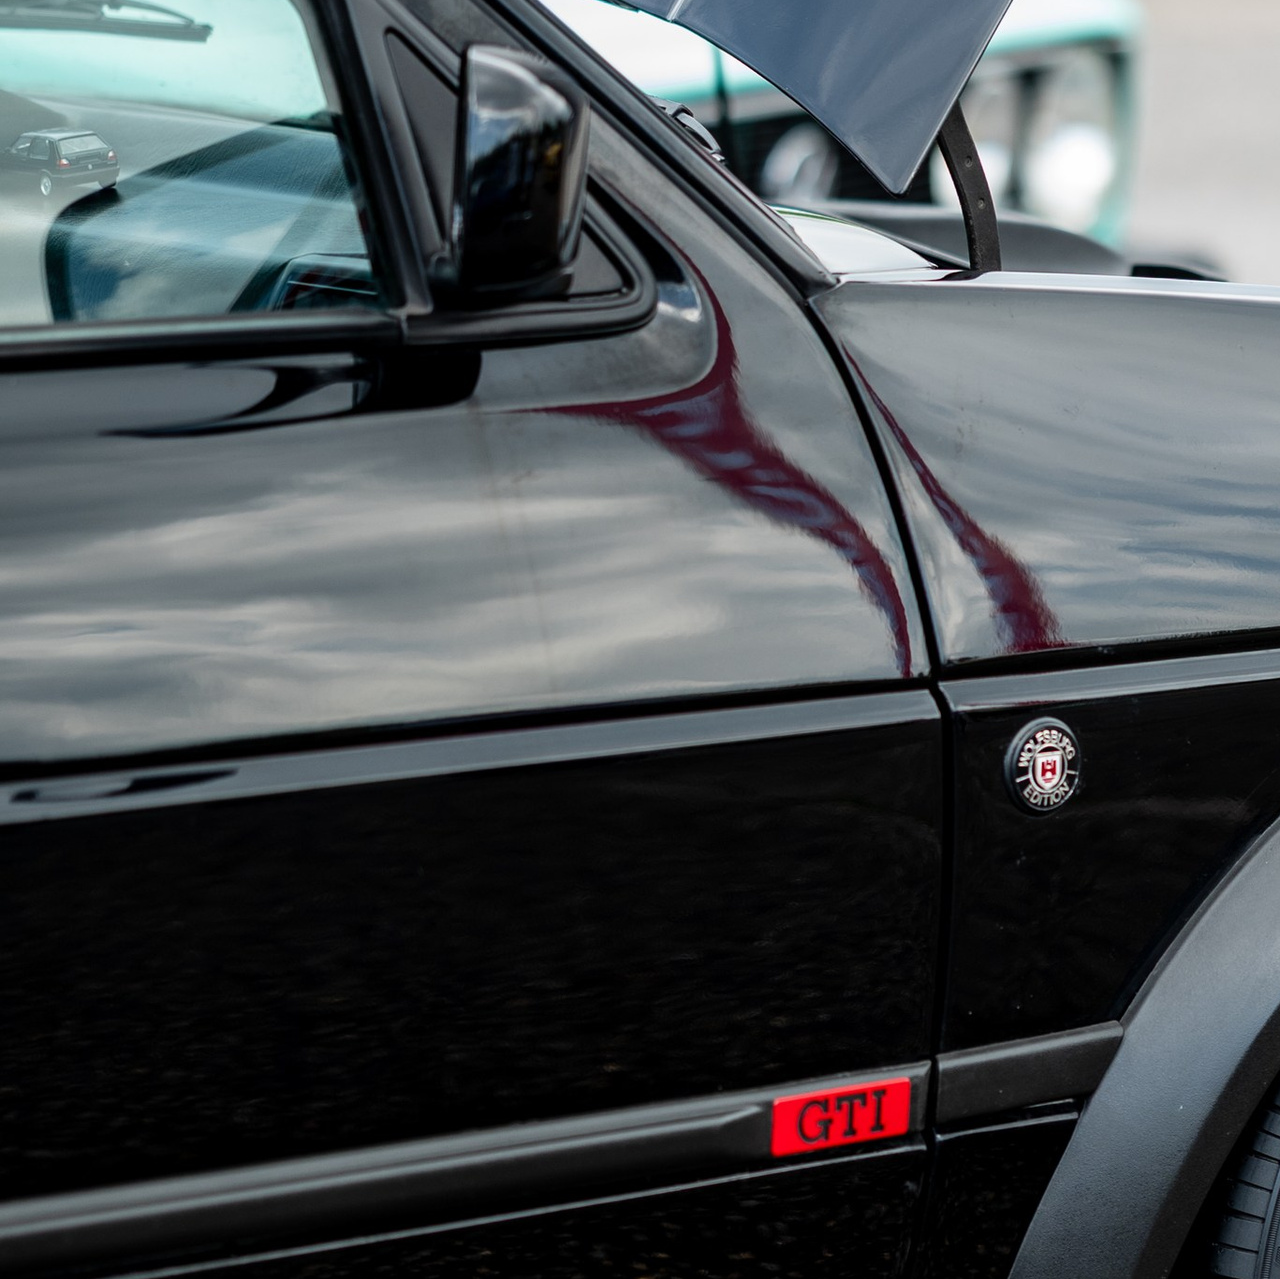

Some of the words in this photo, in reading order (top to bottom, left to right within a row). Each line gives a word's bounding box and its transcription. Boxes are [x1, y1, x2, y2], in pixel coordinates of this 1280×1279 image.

[1018, 729, 1076, 767] WOLFSBURG
[1023, 781, 1070, 806] EDITION
[797, 1088, 887, 1145] GTI
